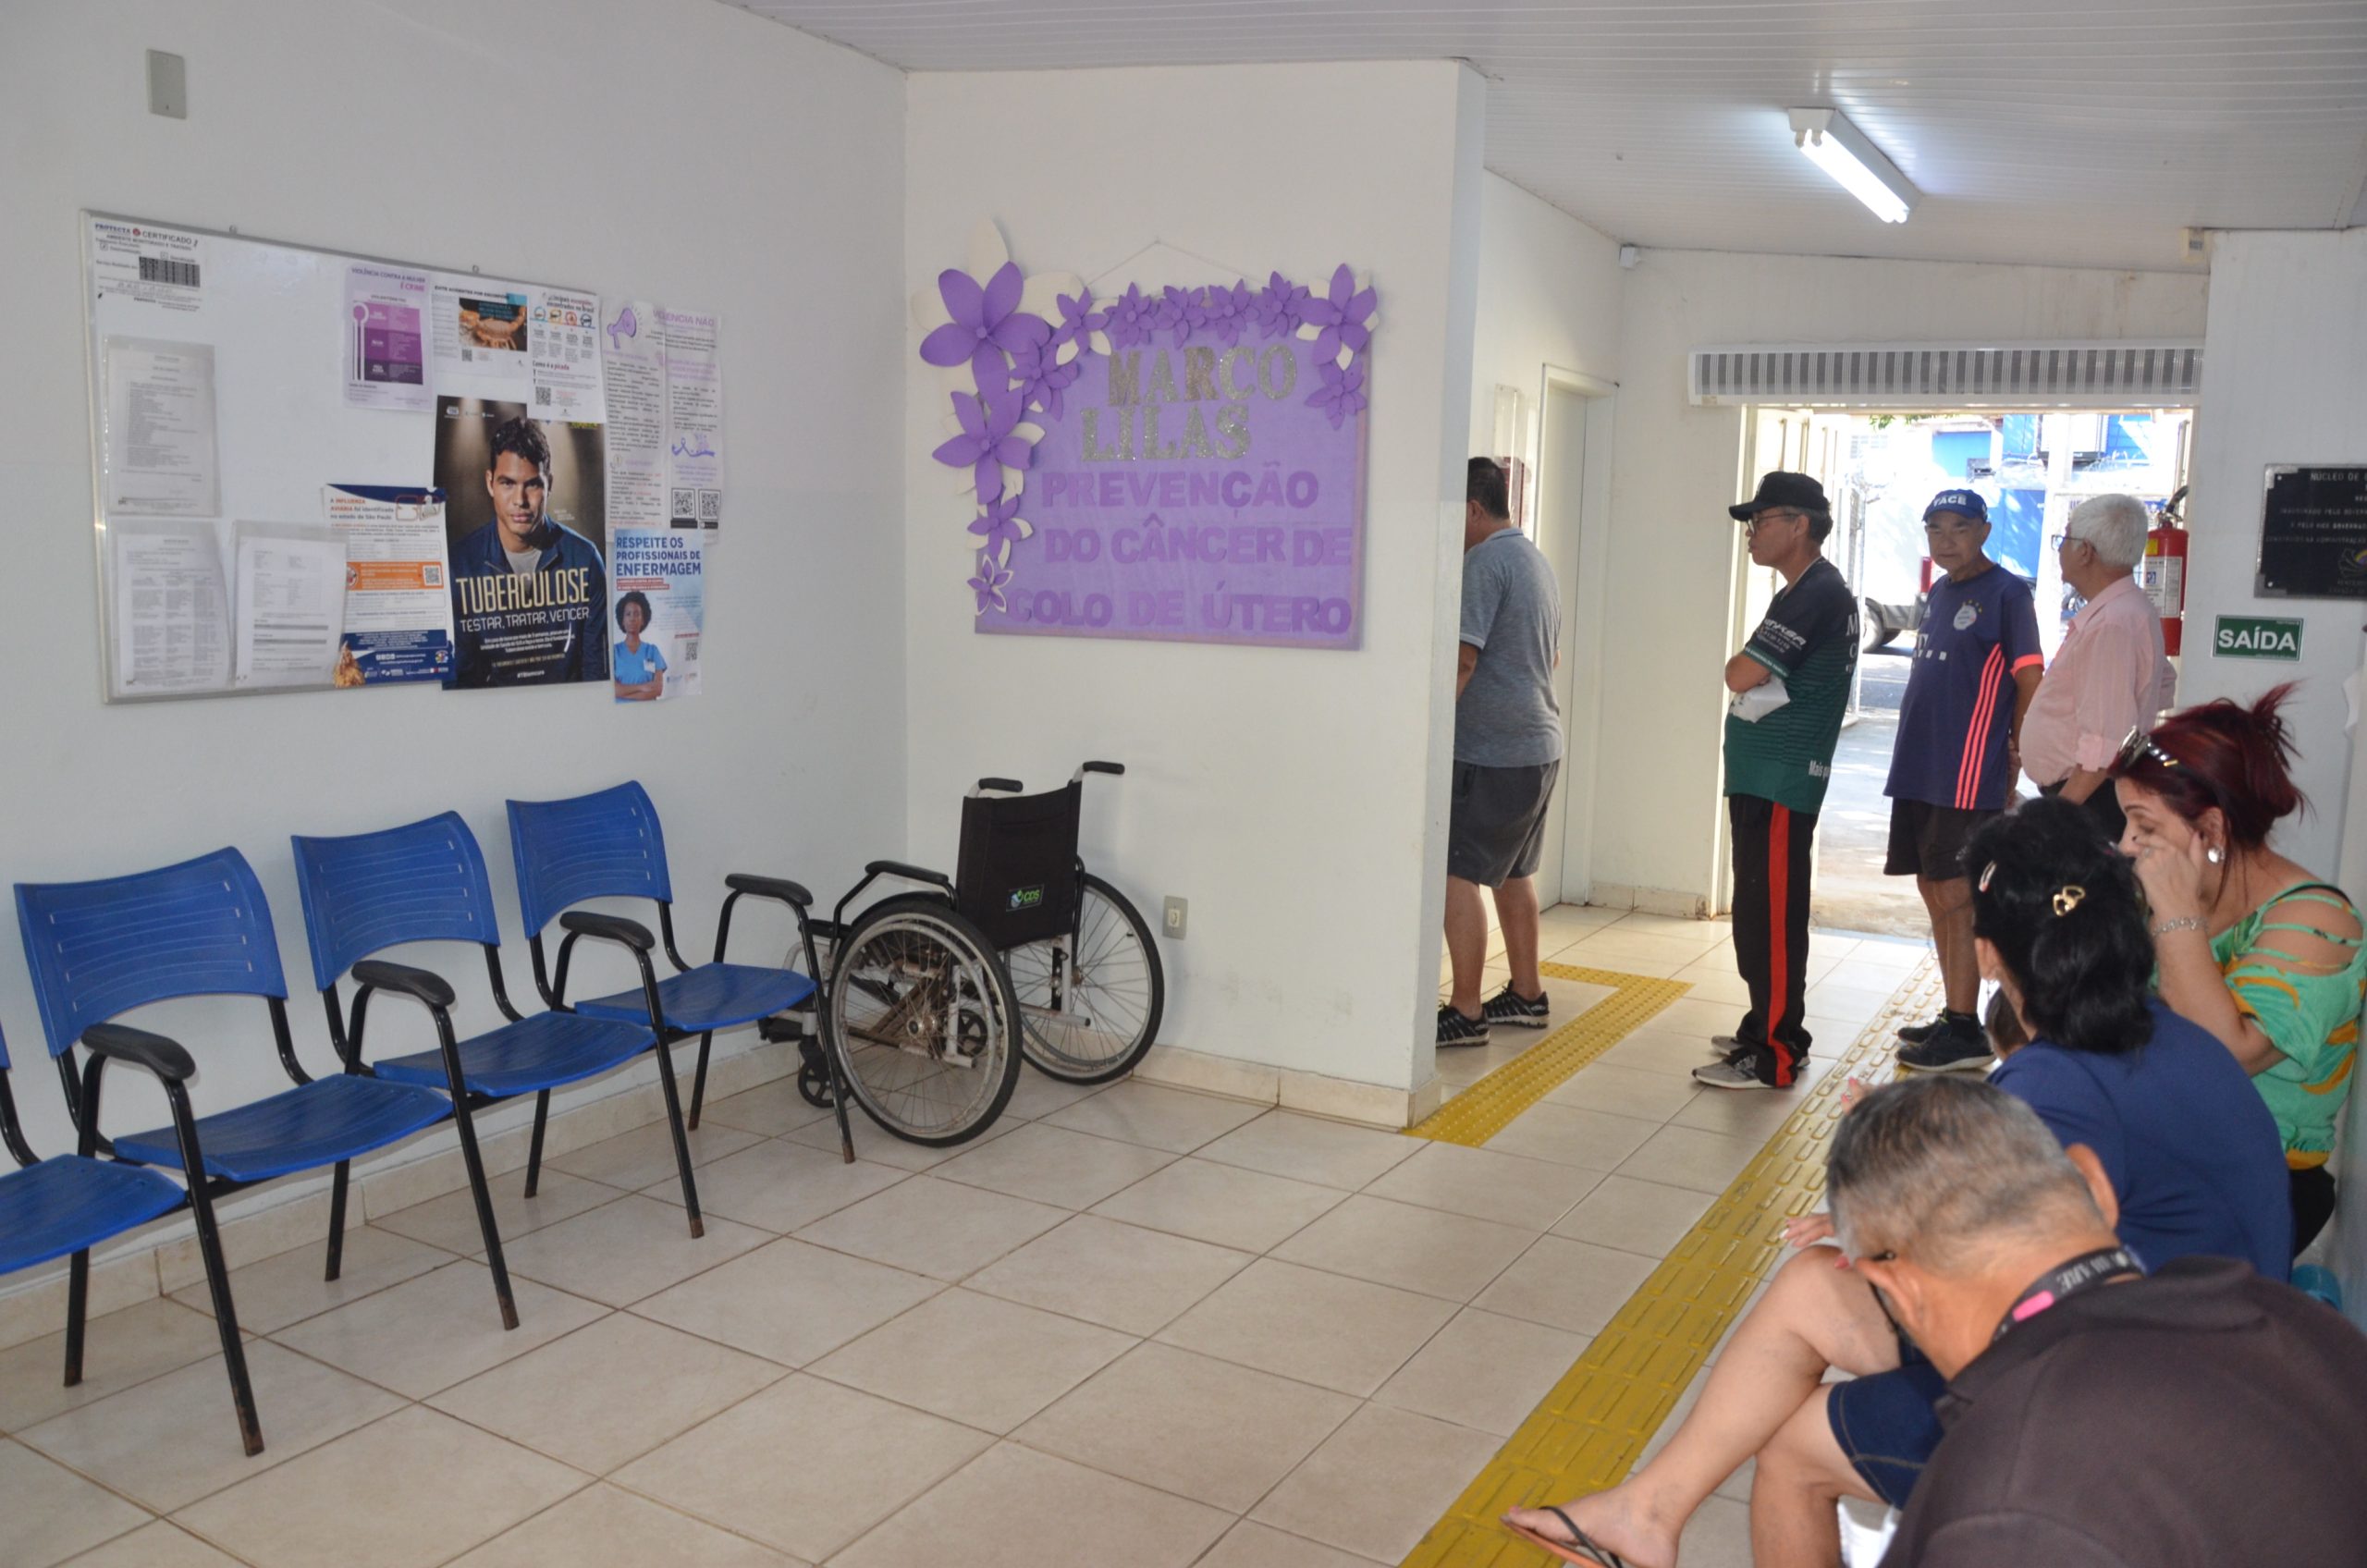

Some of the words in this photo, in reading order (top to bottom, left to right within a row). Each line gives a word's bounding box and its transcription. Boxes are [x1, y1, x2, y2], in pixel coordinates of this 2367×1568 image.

[141, 230, 192, 245] CERTIFICADO
[1081, 404, 1251, 462] LILAS
[1041, 461, 1318, 519] PREVENÇÃO
[616, 537, 668, 548] RESPEITE
[669, 537, 684, 548] OS
[1045, 527, 1101, 564] DO
[1110, 512, 1285, 565] CÂNCER
[1293, 527, 1353, 567] DE
[616, 550, 688, 560] PROFISSIONAIS
[690, 550, 701, 560] DE
[616, 562, 702, 577] ENFERMAGEM
[456, 567, 591, 618] TUBERCULOSE
[1008, 590, 1113, 627] COLO
[1127, 590, 1184, 627] DE
[1205, 580, 1353, 634] ÚTERO
[460, 617, 505, 632] TESTAR.
[505, 612, 549, 628] TRATAR.
[2217, 625, 2297, 652] SAÍDA
